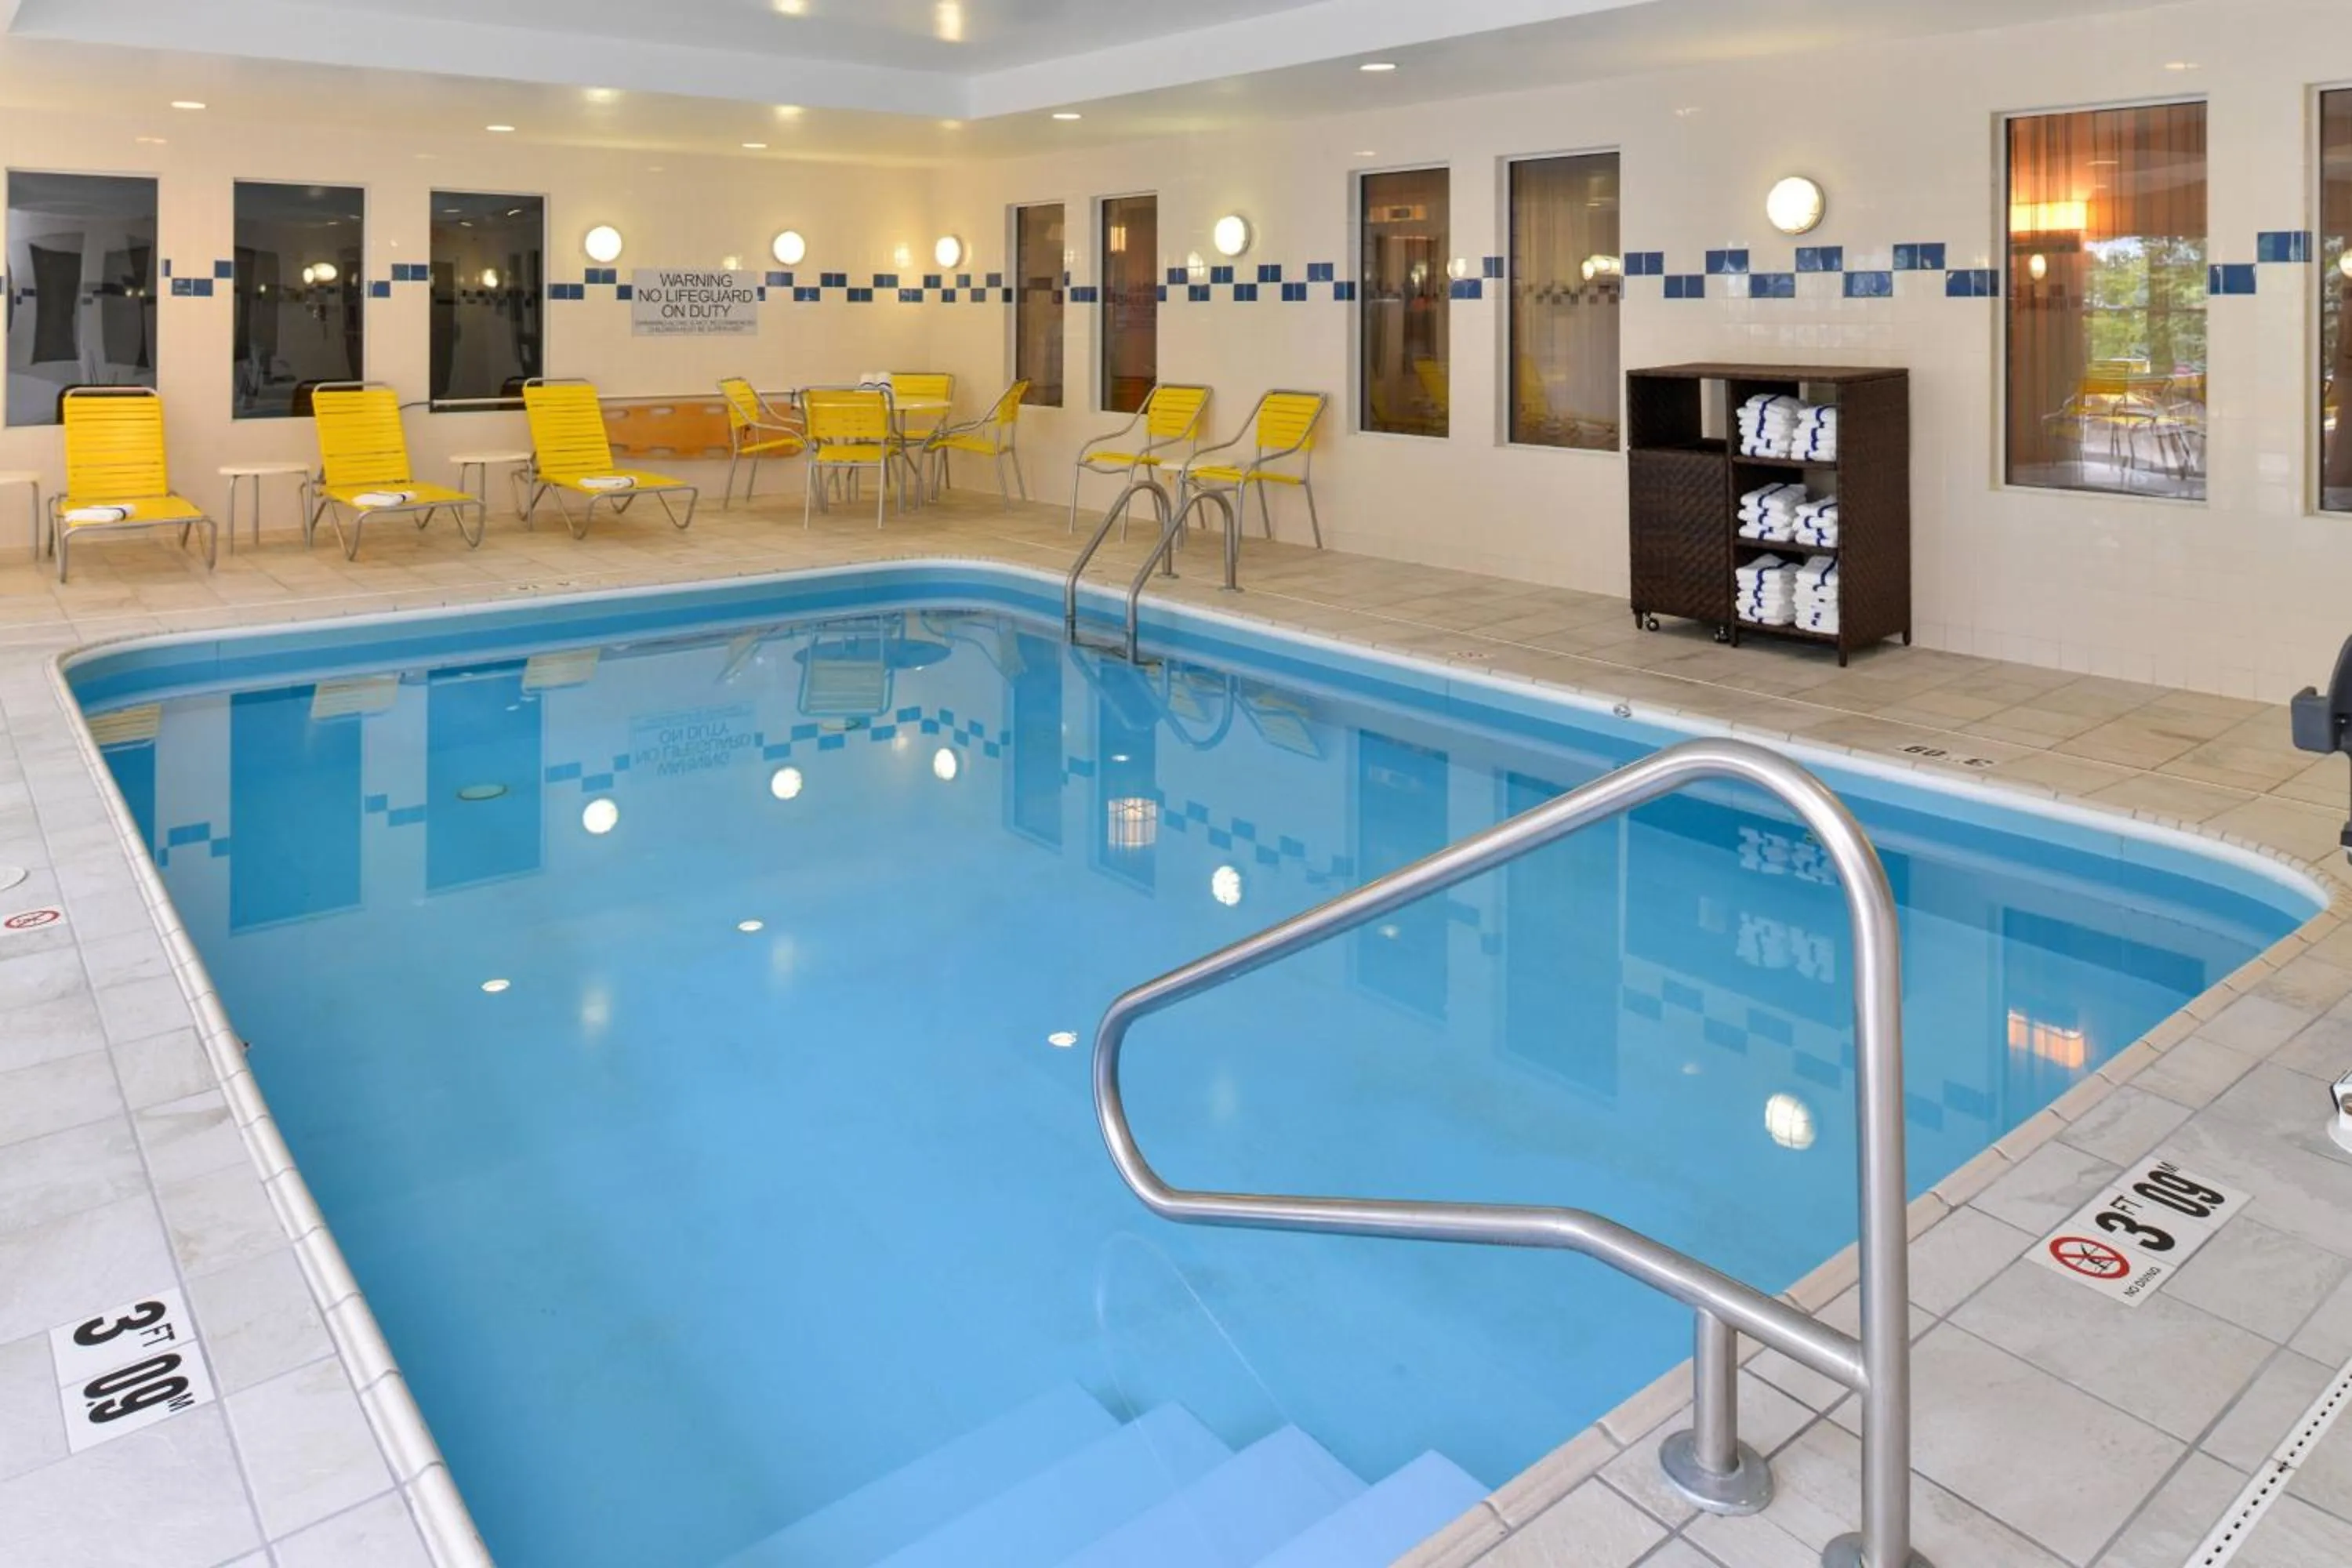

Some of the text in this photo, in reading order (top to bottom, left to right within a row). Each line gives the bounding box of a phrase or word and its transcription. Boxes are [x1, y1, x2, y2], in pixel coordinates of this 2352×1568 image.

[659, 273, 733, 288] WARNING
[638, 289, 753, 303] NO LIFEGUARD
[661, 303, 731, 318] ON DUTY
[2109, 1195, 2144, 1216] FT
[2132, 1171, 2225, 1218] 0.9
[2095, 1211, 2176, 1252] 3
[2123, 1266, 2161, 1298] NO DIVING
[73, 1301, 195, 1424] 3 FT 0.9 M
